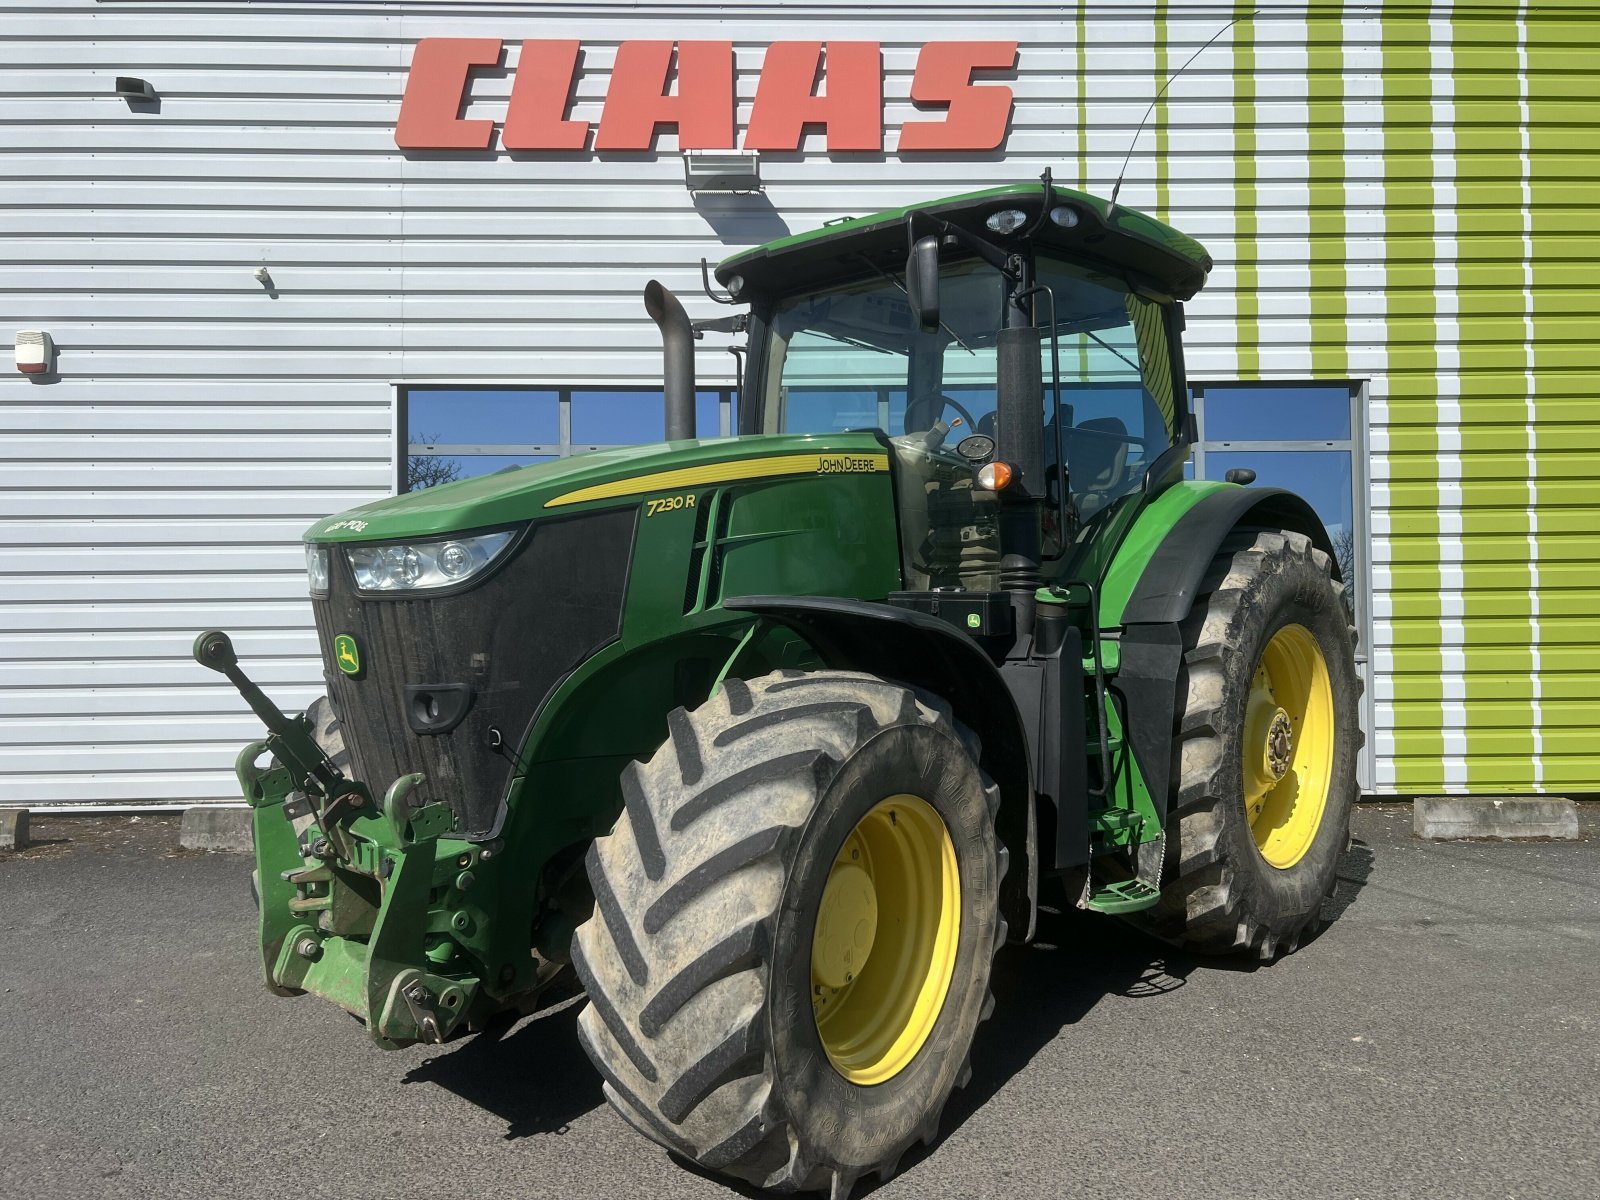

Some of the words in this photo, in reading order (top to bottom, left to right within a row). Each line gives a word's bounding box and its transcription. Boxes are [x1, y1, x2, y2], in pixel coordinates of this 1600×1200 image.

[394, 37, 1019, 151] CLAAS
[817, 456, 844, 471] JOHN
[844, 456, 875, 471] DEERE
[647, 496, 684, 517] 7230
[685, 494, 696, 508] R
